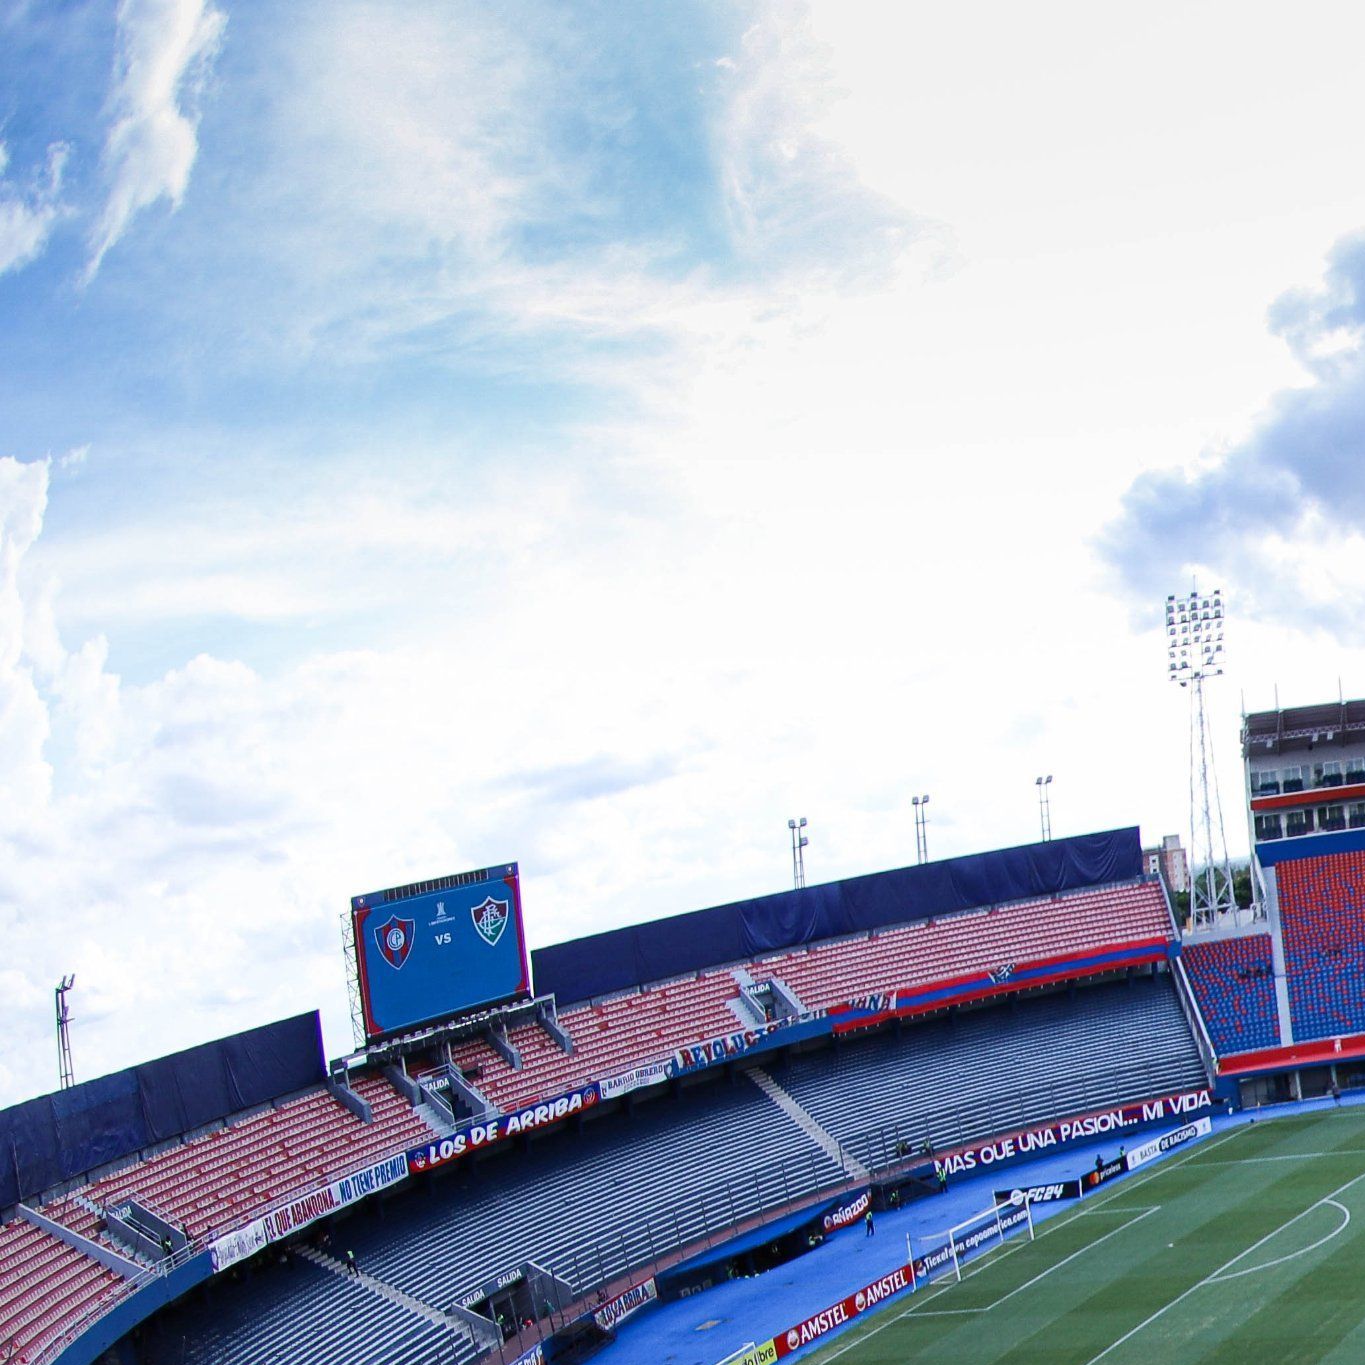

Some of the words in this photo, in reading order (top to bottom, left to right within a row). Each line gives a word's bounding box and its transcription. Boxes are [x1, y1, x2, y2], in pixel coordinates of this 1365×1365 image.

[435, 933, 451, 945] VS
[608, 1072, 634, 1089] BARRIO
[635, 1064, 665, 1082] OBRERO
[429, 1134, 466, 1165] LOS
[470, 1122, 499, 1146] DE
[505, 1093, 582, 1136] ARRIBA
[934, 1150, 976, 1176] MAS
[980, 1139, 1015, 1165] QUE
[1018, 1129, 1057, 1153] UNA
[1142, 1100, 1164, 1122] MI
[1168, 1090, 1212, 1116] VIDA
[1160, 1139, 1169, 1151] DE
[1168, 1128, 1197, 1148] RACISMO
[276, 1207, 292, 1235] QUE
[339, 1181, 351, 1204] NO
[351, 1169, 375, 1199] TIENE
[375, 1155, 406, 1185] PREMIO
[497, 1268, 522, 1288] SALIDA
[866, 1268, 908, 1307] AMSTEL
[461, 1288, 486, 1307] SALIDA
[800, 1303, 849, 1344] AMSTEL
